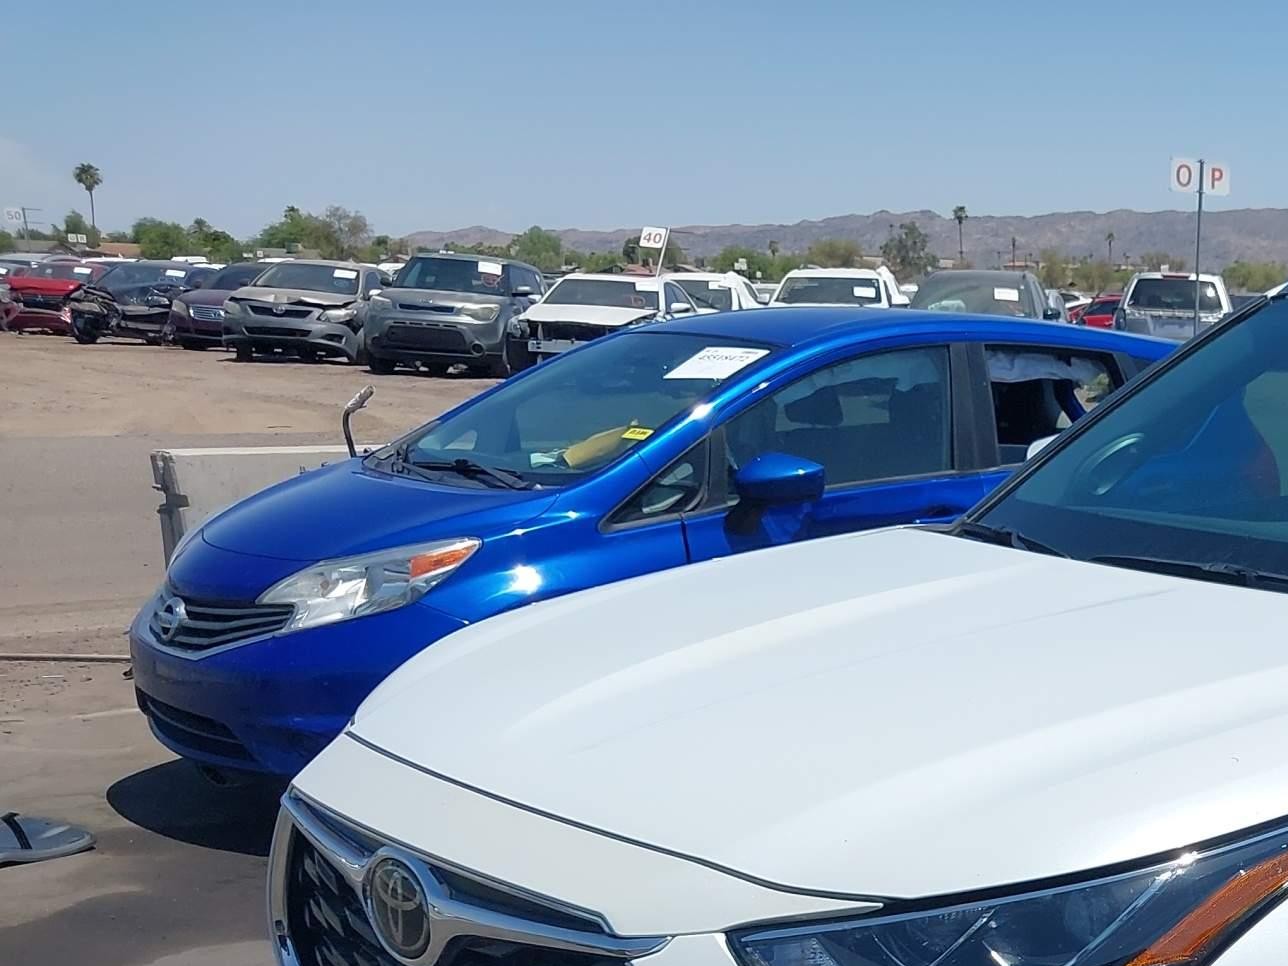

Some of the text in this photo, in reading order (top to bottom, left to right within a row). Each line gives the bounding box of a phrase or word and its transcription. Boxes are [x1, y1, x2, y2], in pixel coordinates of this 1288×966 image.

[1176, 164, 1223, 190] O P
[6, 210, 21, 221] 50
[643, 232, 663, 244] 40
